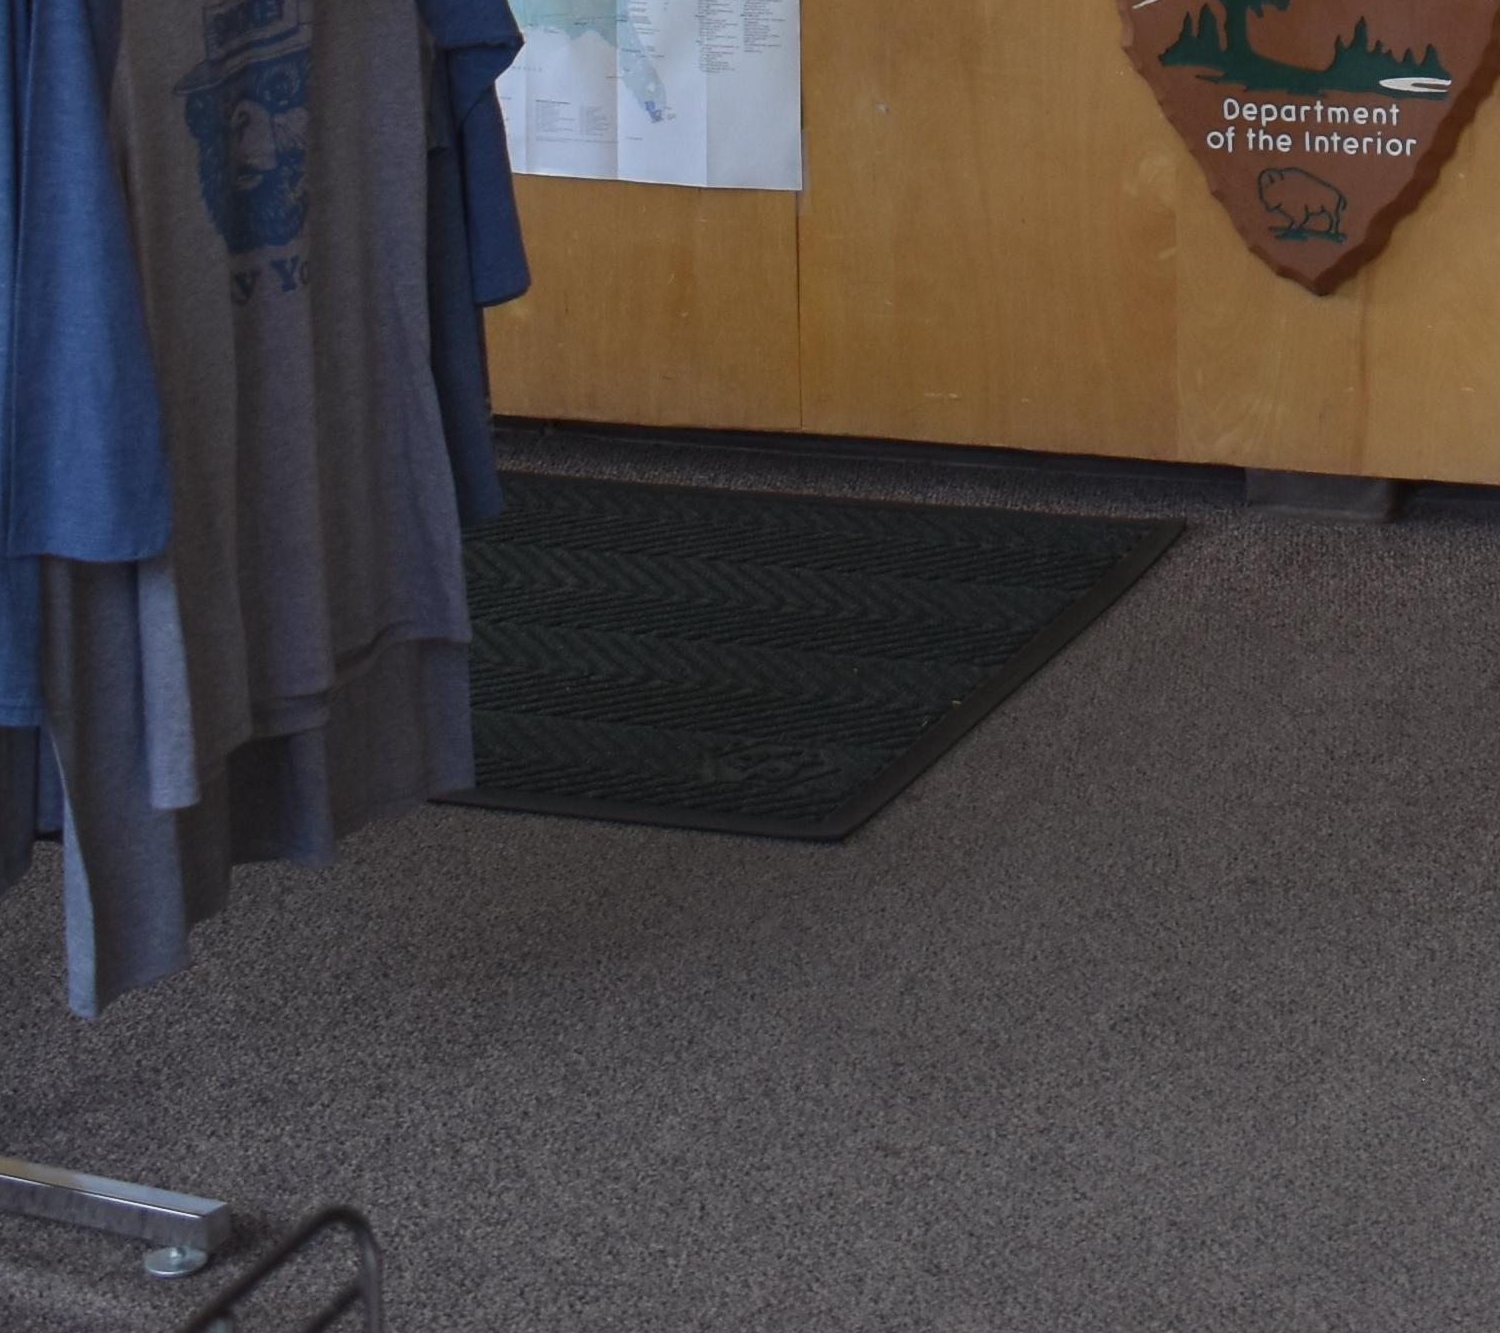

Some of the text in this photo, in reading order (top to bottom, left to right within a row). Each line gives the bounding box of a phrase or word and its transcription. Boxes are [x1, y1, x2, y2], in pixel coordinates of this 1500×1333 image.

[1223, 98, 1400, 127] Department
[1206, 128, 1418, 156] of the Interior
